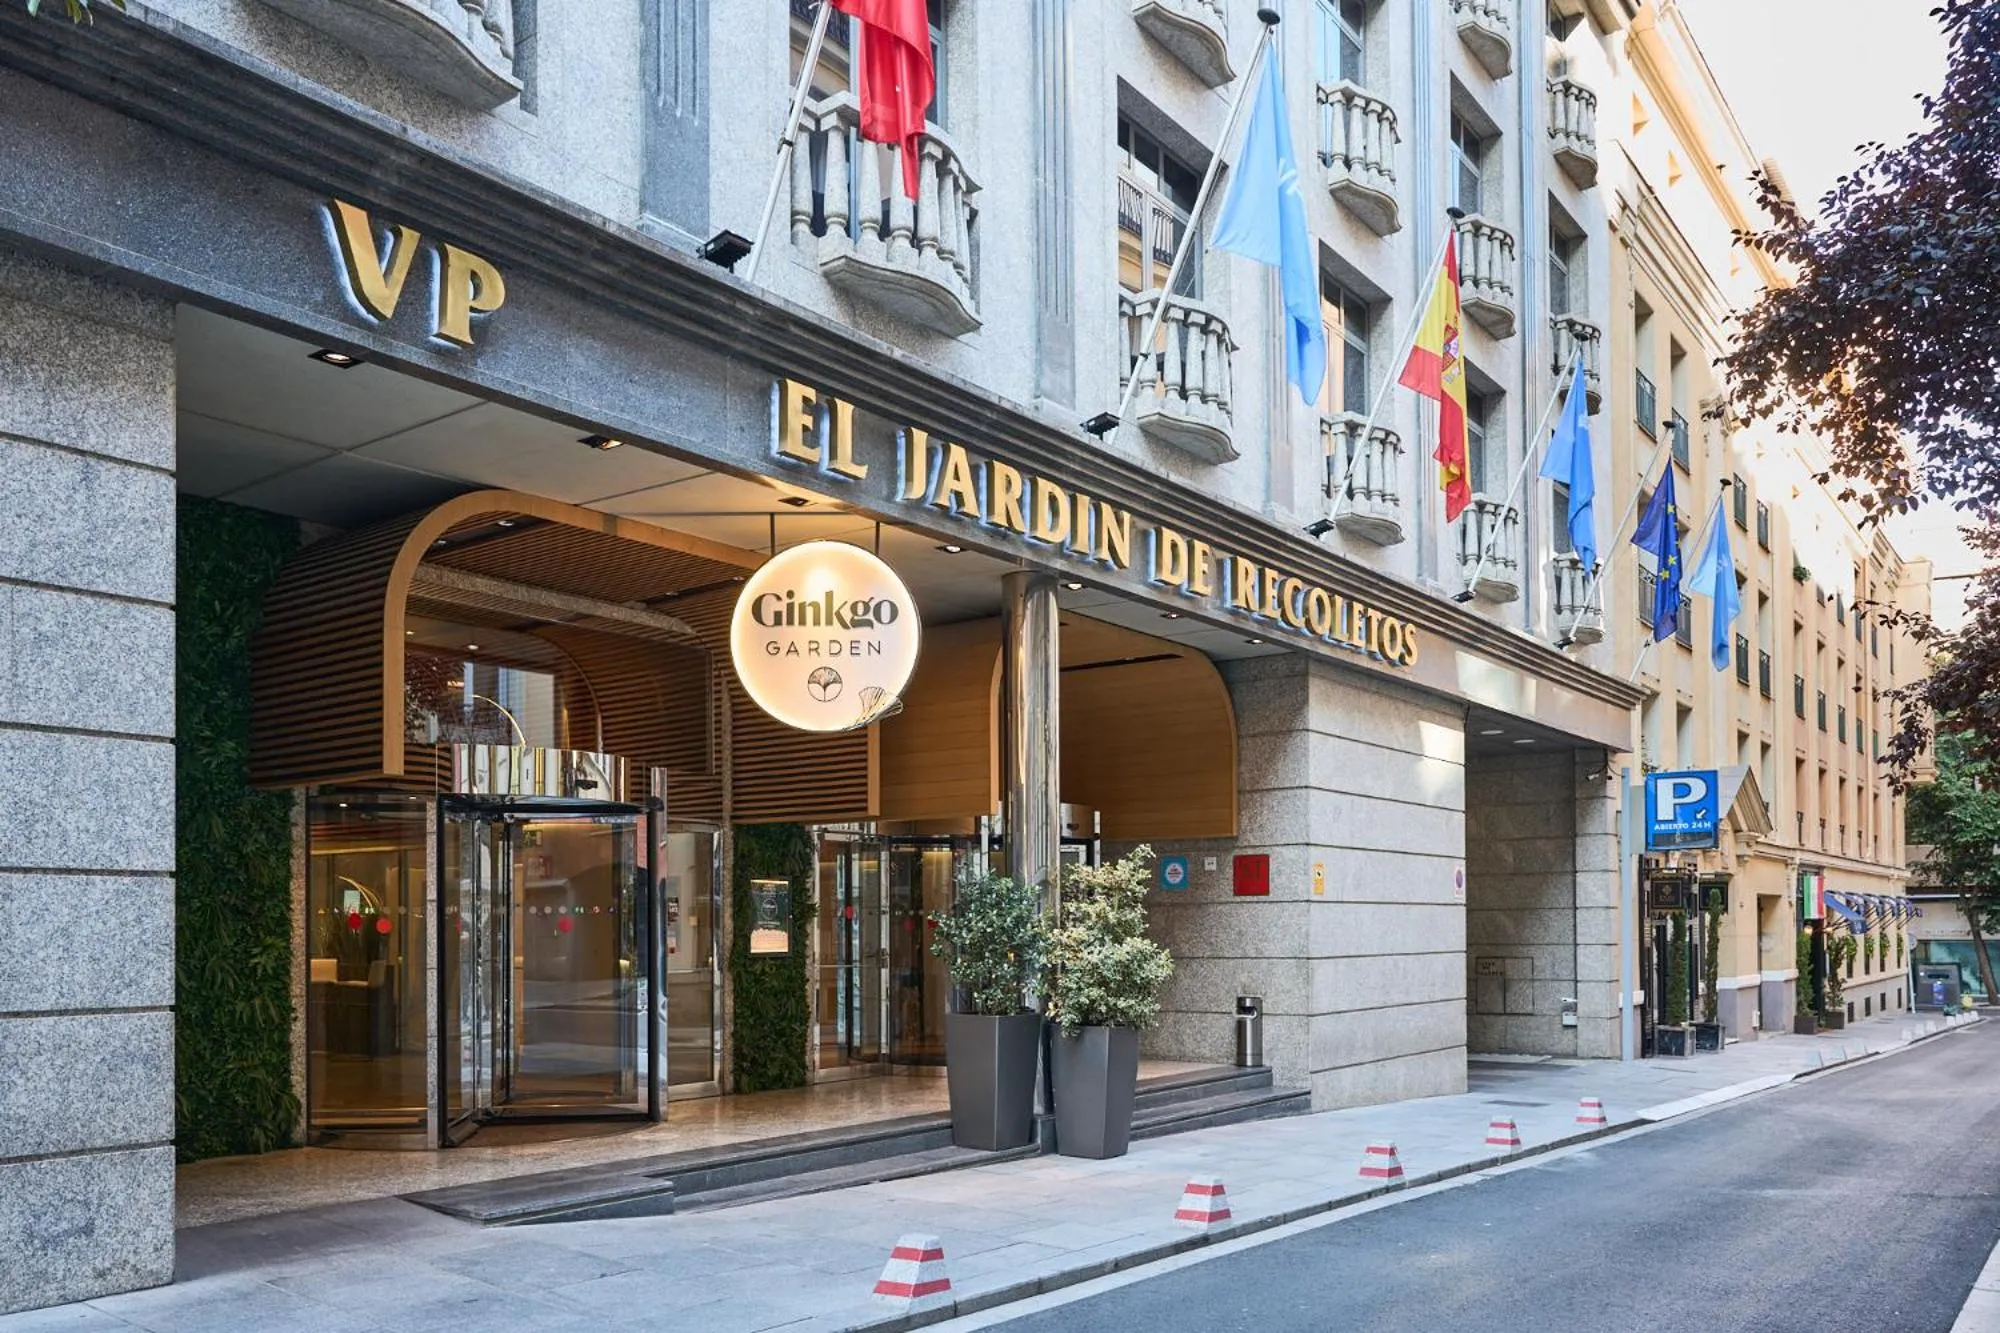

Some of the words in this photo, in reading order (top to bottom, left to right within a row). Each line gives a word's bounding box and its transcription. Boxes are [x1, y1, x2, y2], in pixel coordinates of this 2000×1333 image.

[329, 199, 506, 348] VP
[777, 378, 868, 481] EL
[901, 426, 1131, 569] JARDIN
[1153, 526, 1212, 597] DE
[1230, 555, 1418, 667] RECOLETOS
[751, 589, 899, 630] Ginkgo
[766, 639, 882, 657] GARDEN
[1656, 777, 1708, 821] P
[1654, 822, 1689, 831] ABIERTO
